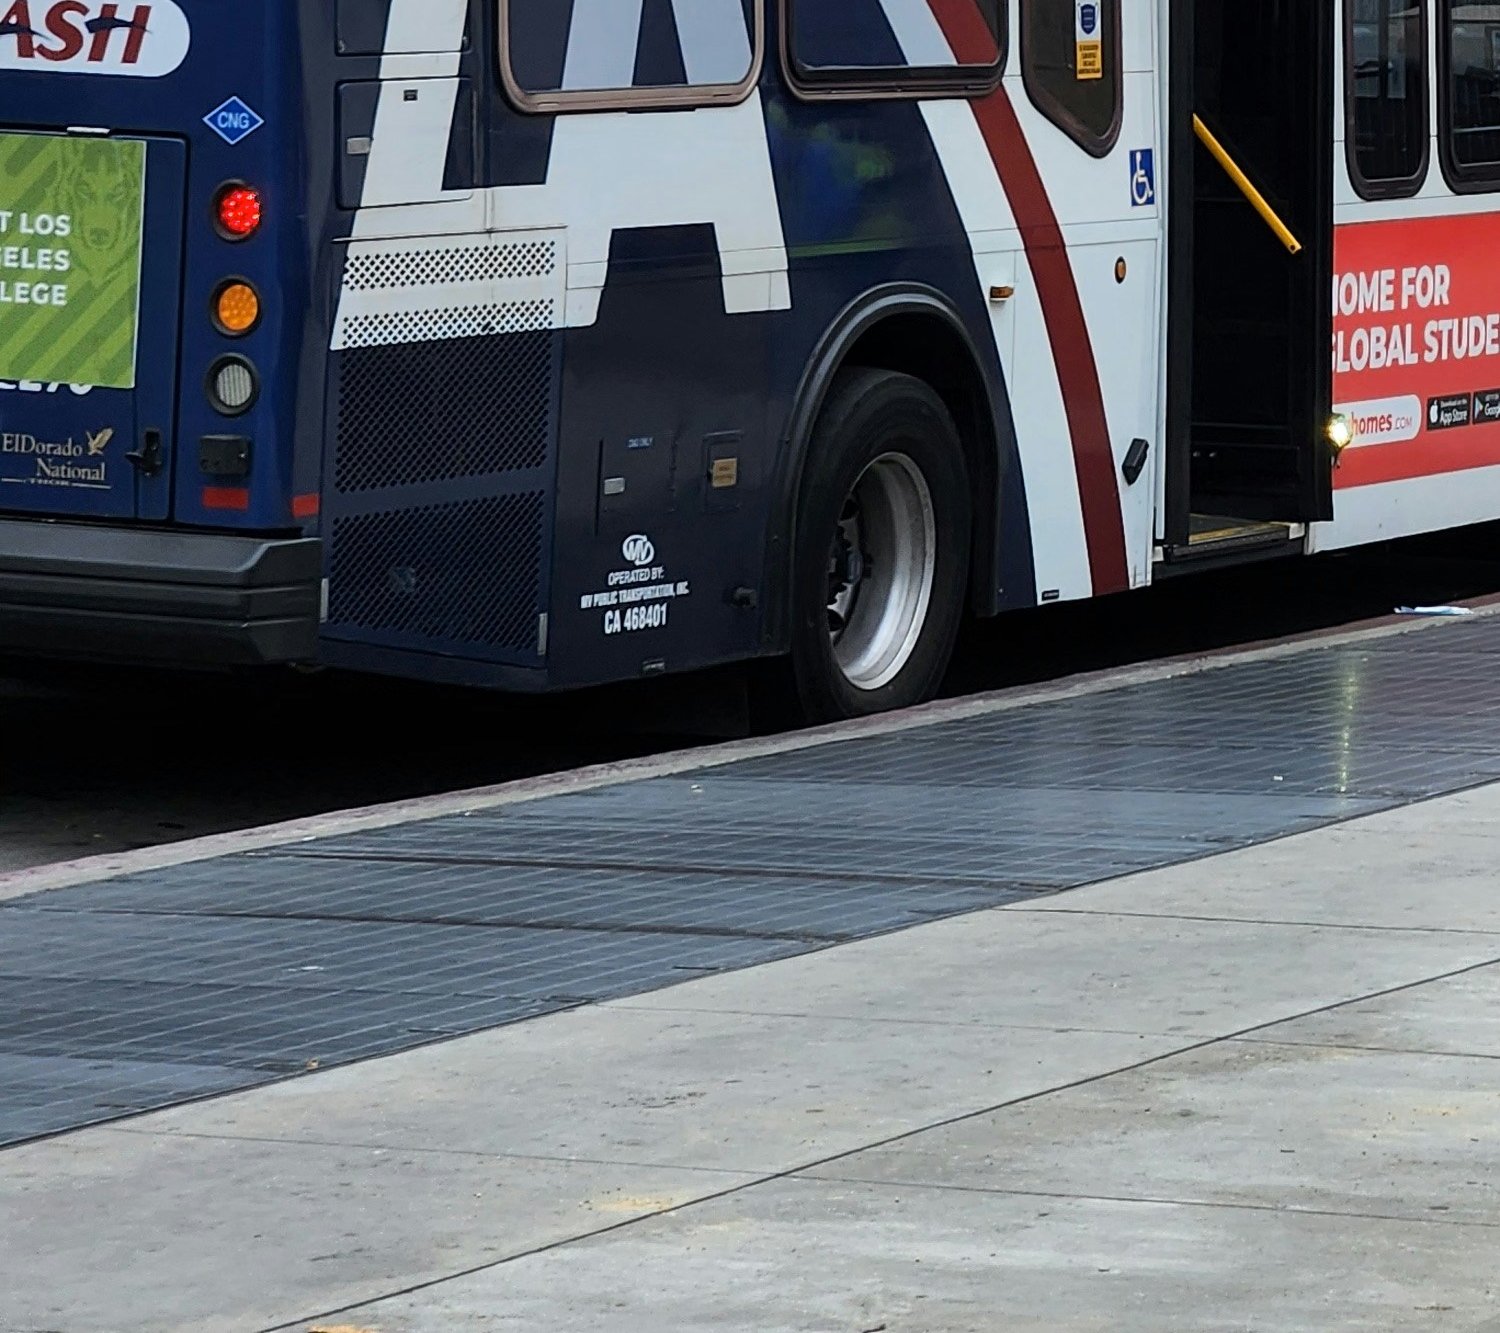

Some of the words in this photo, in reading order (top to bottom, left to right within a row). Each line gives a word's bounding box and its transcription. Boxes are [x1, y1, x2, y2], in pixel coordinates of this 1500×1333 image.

[217, 111, 250, 129] CNG
[19, 213, 71, 236] LOS
[0, 247, 71, 271] ELES
[0, 281, 68, 306] LEGE
[1401, 265, 1450, 309] FOR
[1332, 323, 1418, 374] LOBAL
[1439, 410, 1453, 426] App
[1452, 408, 1468, 422] Store
[2, 433, 83, 456] ElDorado
[36, 457, 105, 481] National
[608, 568, 650, 586] OPERATED
[651, 566, 665, 580] BY:
[593, 590, 618, 607] PUBLIC
[604, 610, 621, 635] CA
[623, 602, 668, 632] 468401
